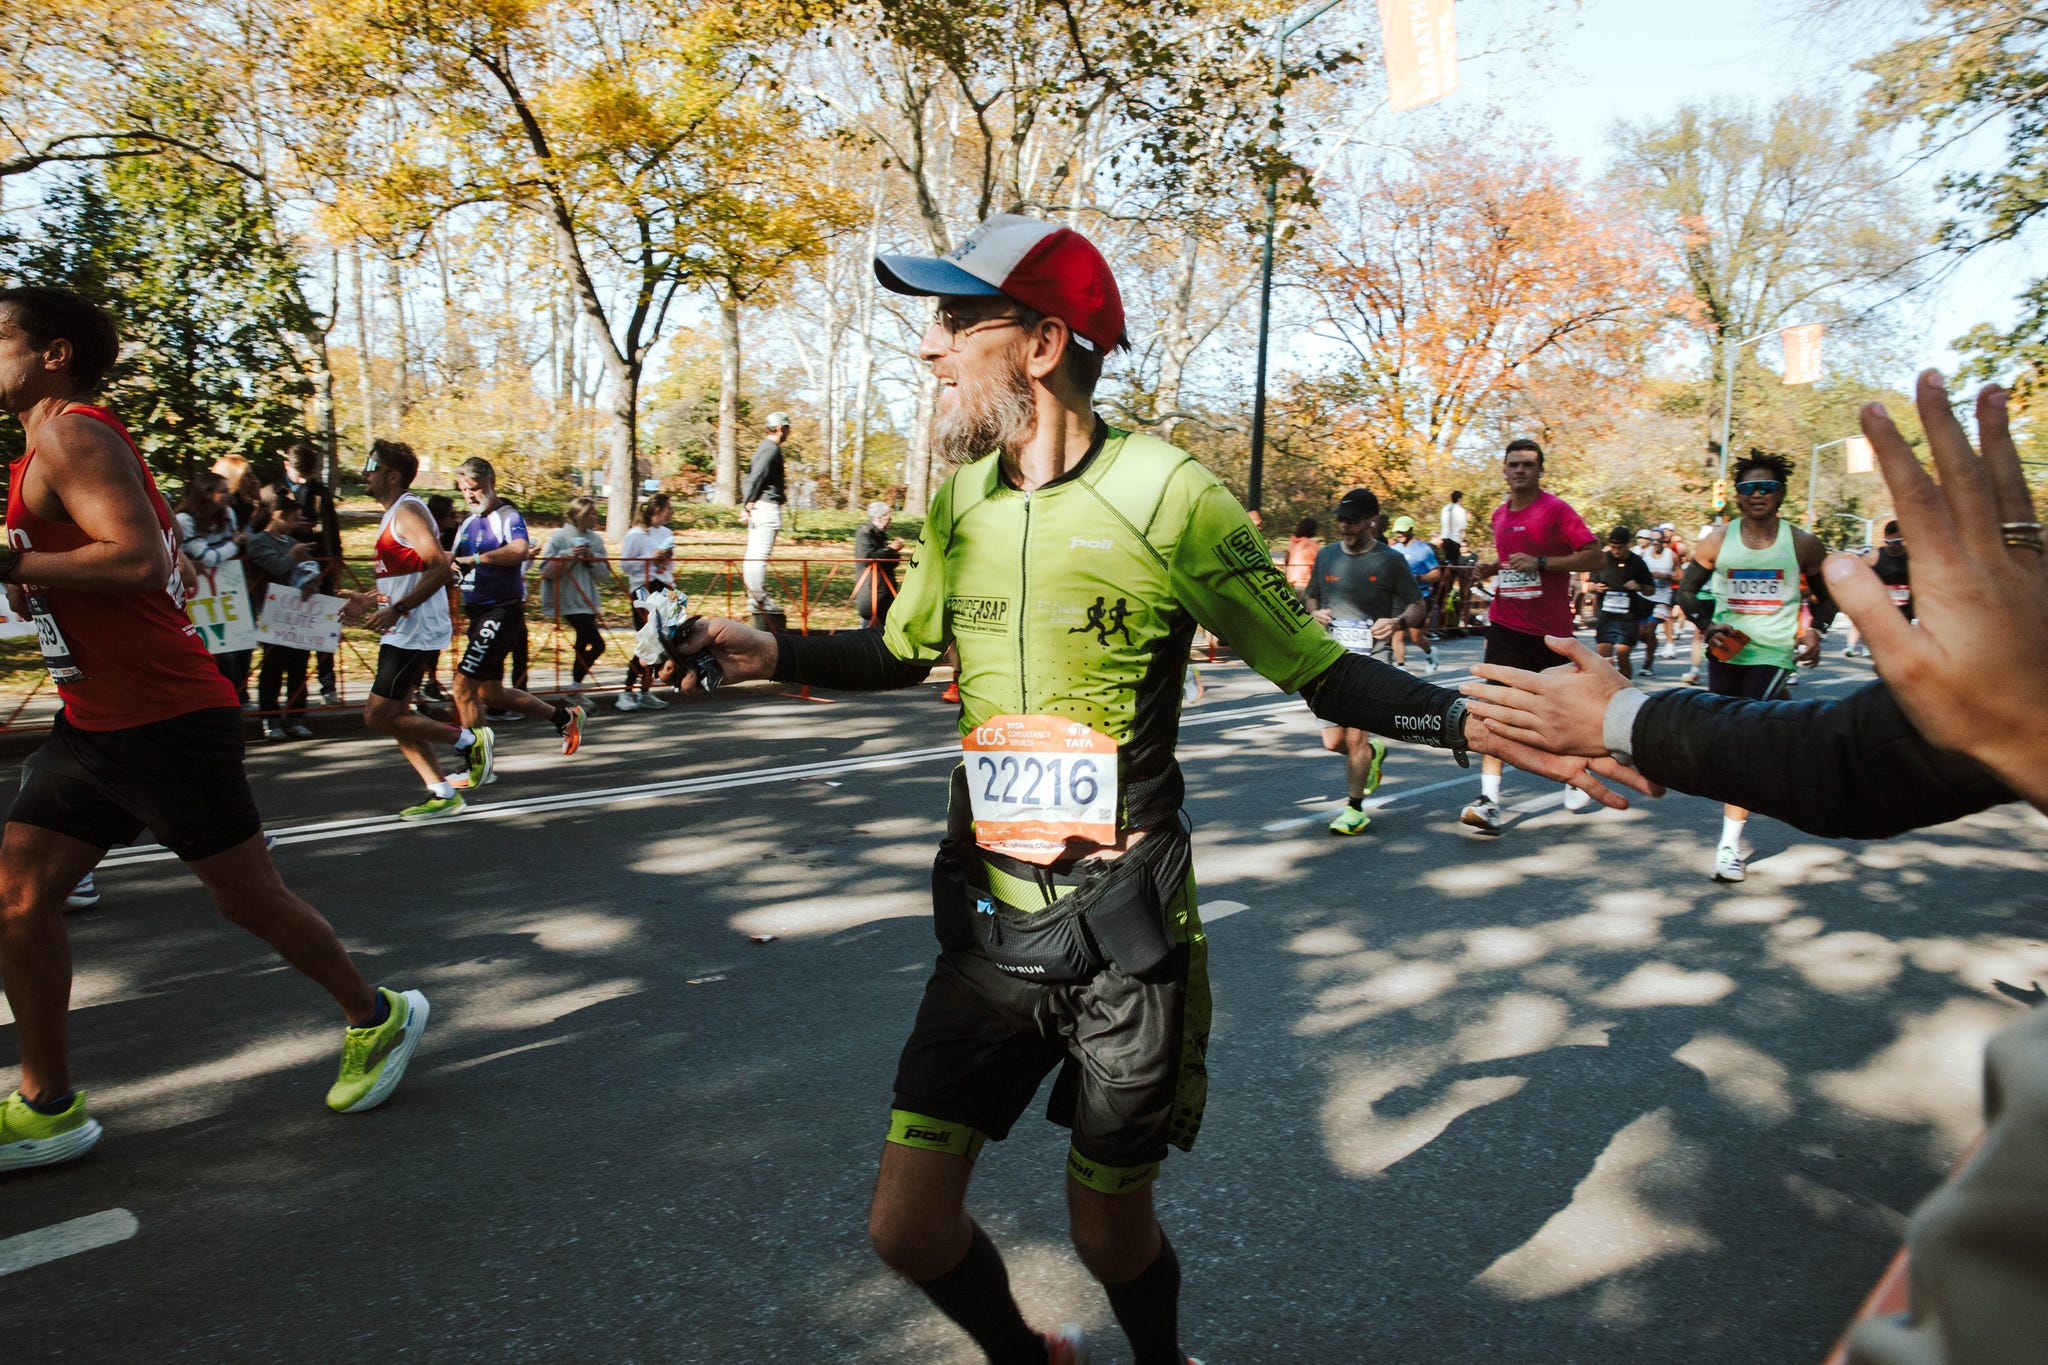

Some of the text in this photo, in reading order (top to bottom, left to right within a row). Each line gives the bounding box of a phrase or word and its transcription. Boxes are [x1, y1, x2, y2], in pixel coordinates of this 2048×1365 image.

[1070, 537, 1113, 550] poli
[1733, 580, 1779, 594] 10326
[35, 617, 58, 646] 39
[462, 619, 501, 674] HLK-92
[1064, 739, 1094, 749] TATA
[978, 756, 1099, 806] 22216
[995, 962, 1046, 974] KIPRUN
[903, 1127, 951, 1144] poli
